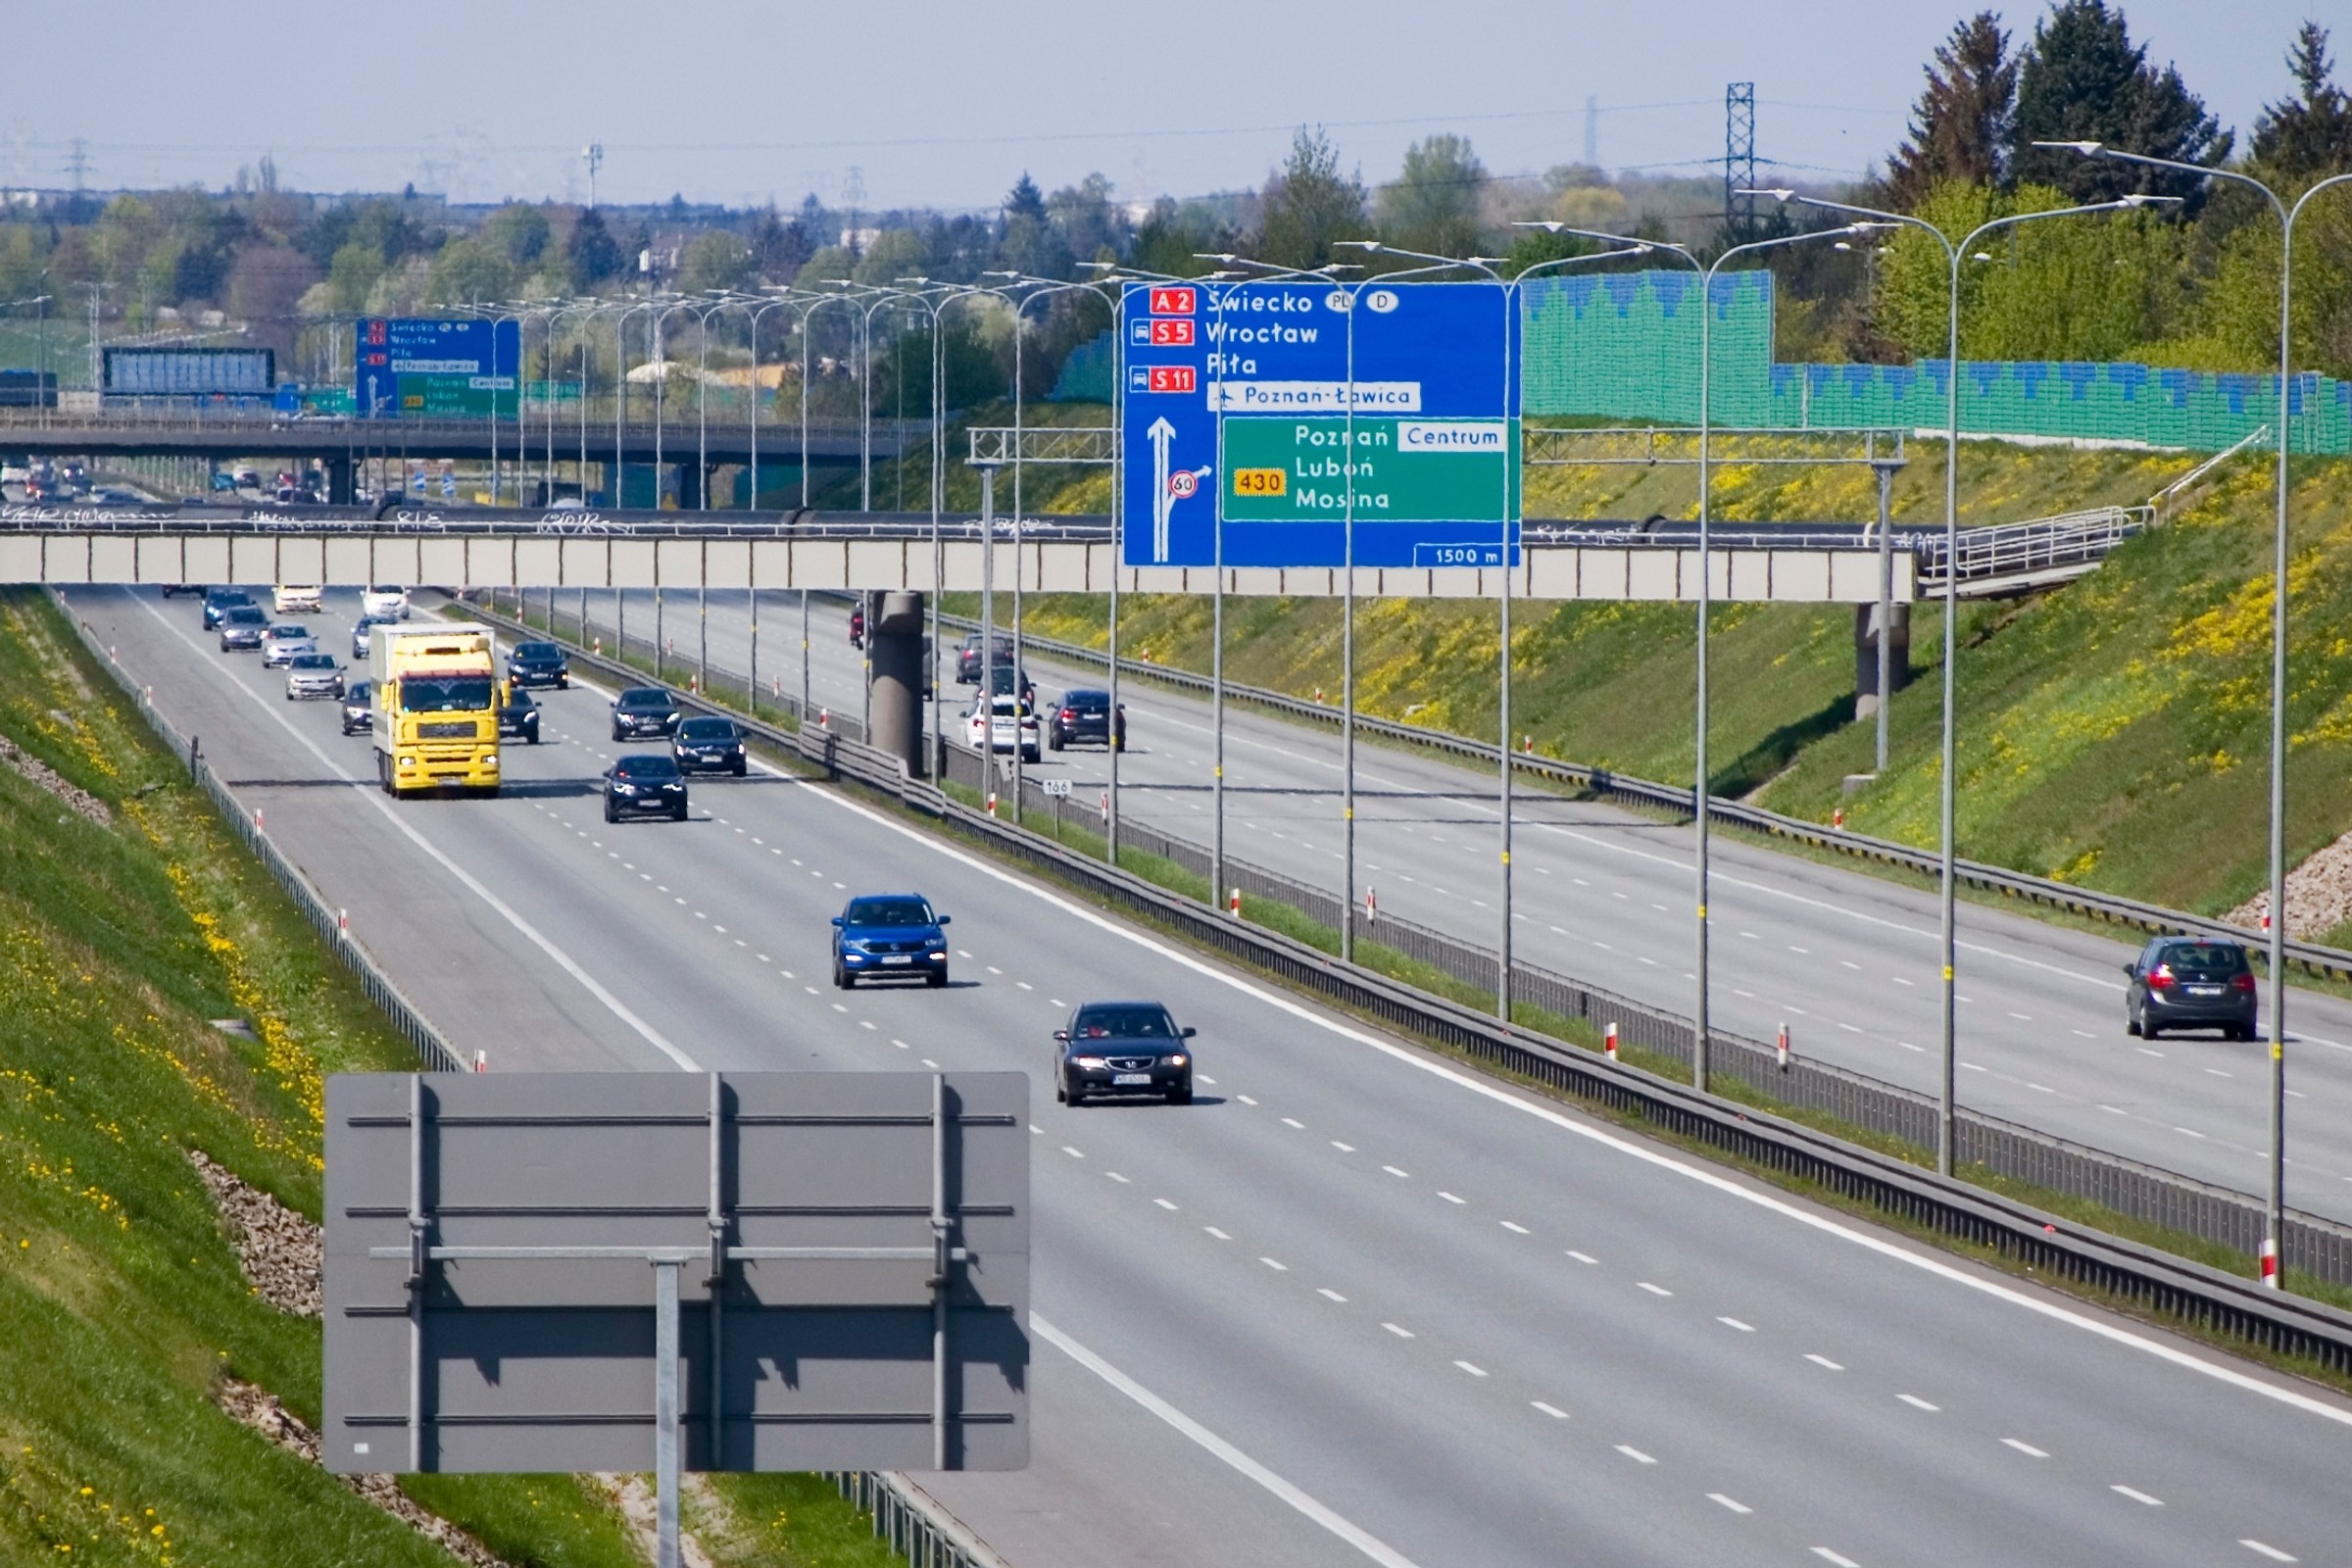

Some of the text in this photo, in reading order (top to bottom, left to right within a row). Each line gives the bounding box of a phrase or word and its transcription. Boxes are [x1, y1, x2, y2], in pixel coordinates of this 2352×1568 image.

[1156, 292, 1189, 311] A 2
[1206, 284, 1312, 312] Świecko
[1333, 295, 1349, 308] PL
[1378, 295, 1388, 308] D
[1157, 323, 1188, 341] S 5
[1205, 321, 1318, 343] Wrocław
[1206, 353, 1256, 373] Piła
[1155, 370, 1189, 389] S 11
[1246, 386, 1409, 404] Poznań-Ławica
[1296, 424, 1498, 446] Poznań Centrum
[1296, 456, 1373, 477] Luboń
[1174, 477, 1193, 491] 60
[1241, 473, 1280, 491] 430
[1296, 488, 1390, 509] Mosina
[1437, 549, 1497, 563] 1500 m
[1048, 781, 1067, 793] 166
